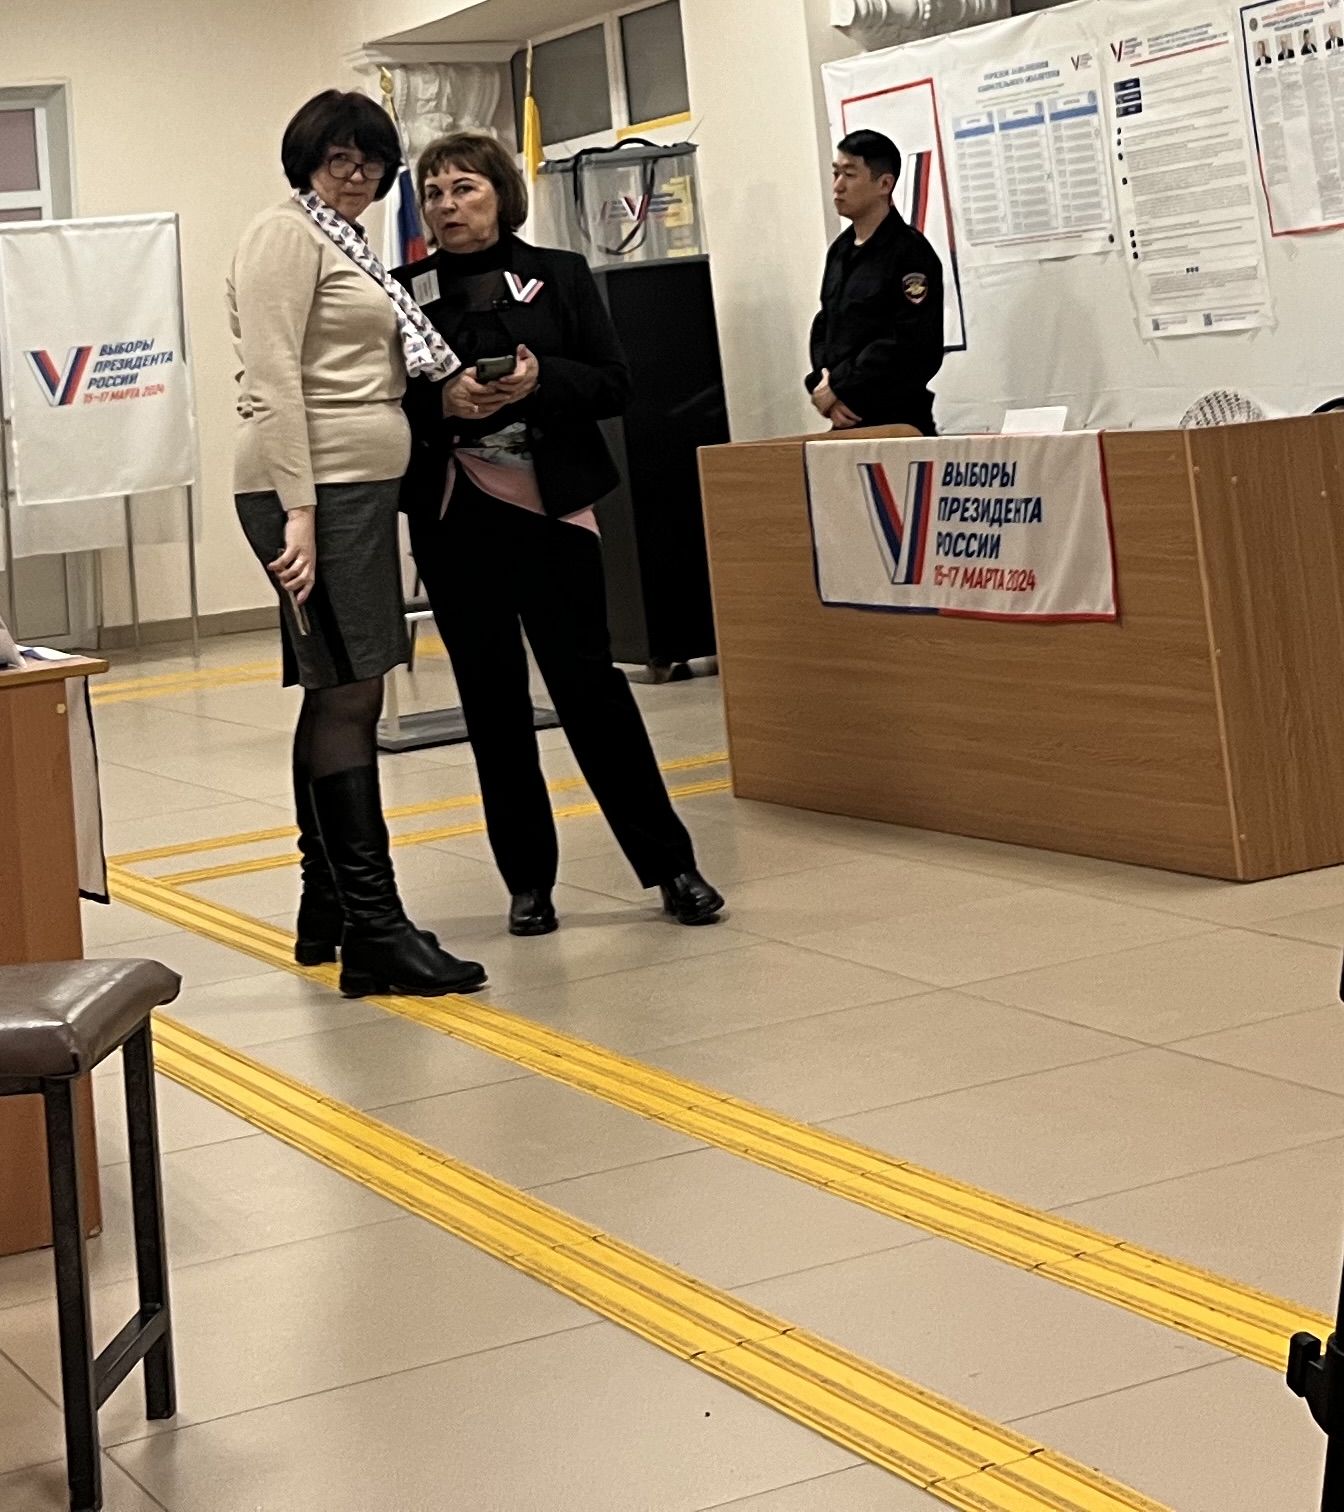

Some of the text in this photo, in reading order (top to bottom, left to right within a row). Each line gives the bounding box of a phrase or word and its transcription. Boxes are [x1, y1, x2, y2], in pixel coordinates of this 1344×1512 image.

[99, 338, 155, 356] ВЫБОРЫ
[93, 351, 173, 373] ПРЕЗИДЕНТА
[87, 373, 139, 390] РОССИИ
[941, 461, 1017, 487] ВЫБОРЫ
[938, 496, 1042, 527] ПРЕЗИДЕНТА
[936, 531, 1001, 559] РОССИИ
[960, 566, 1005, 590] МАРТА
